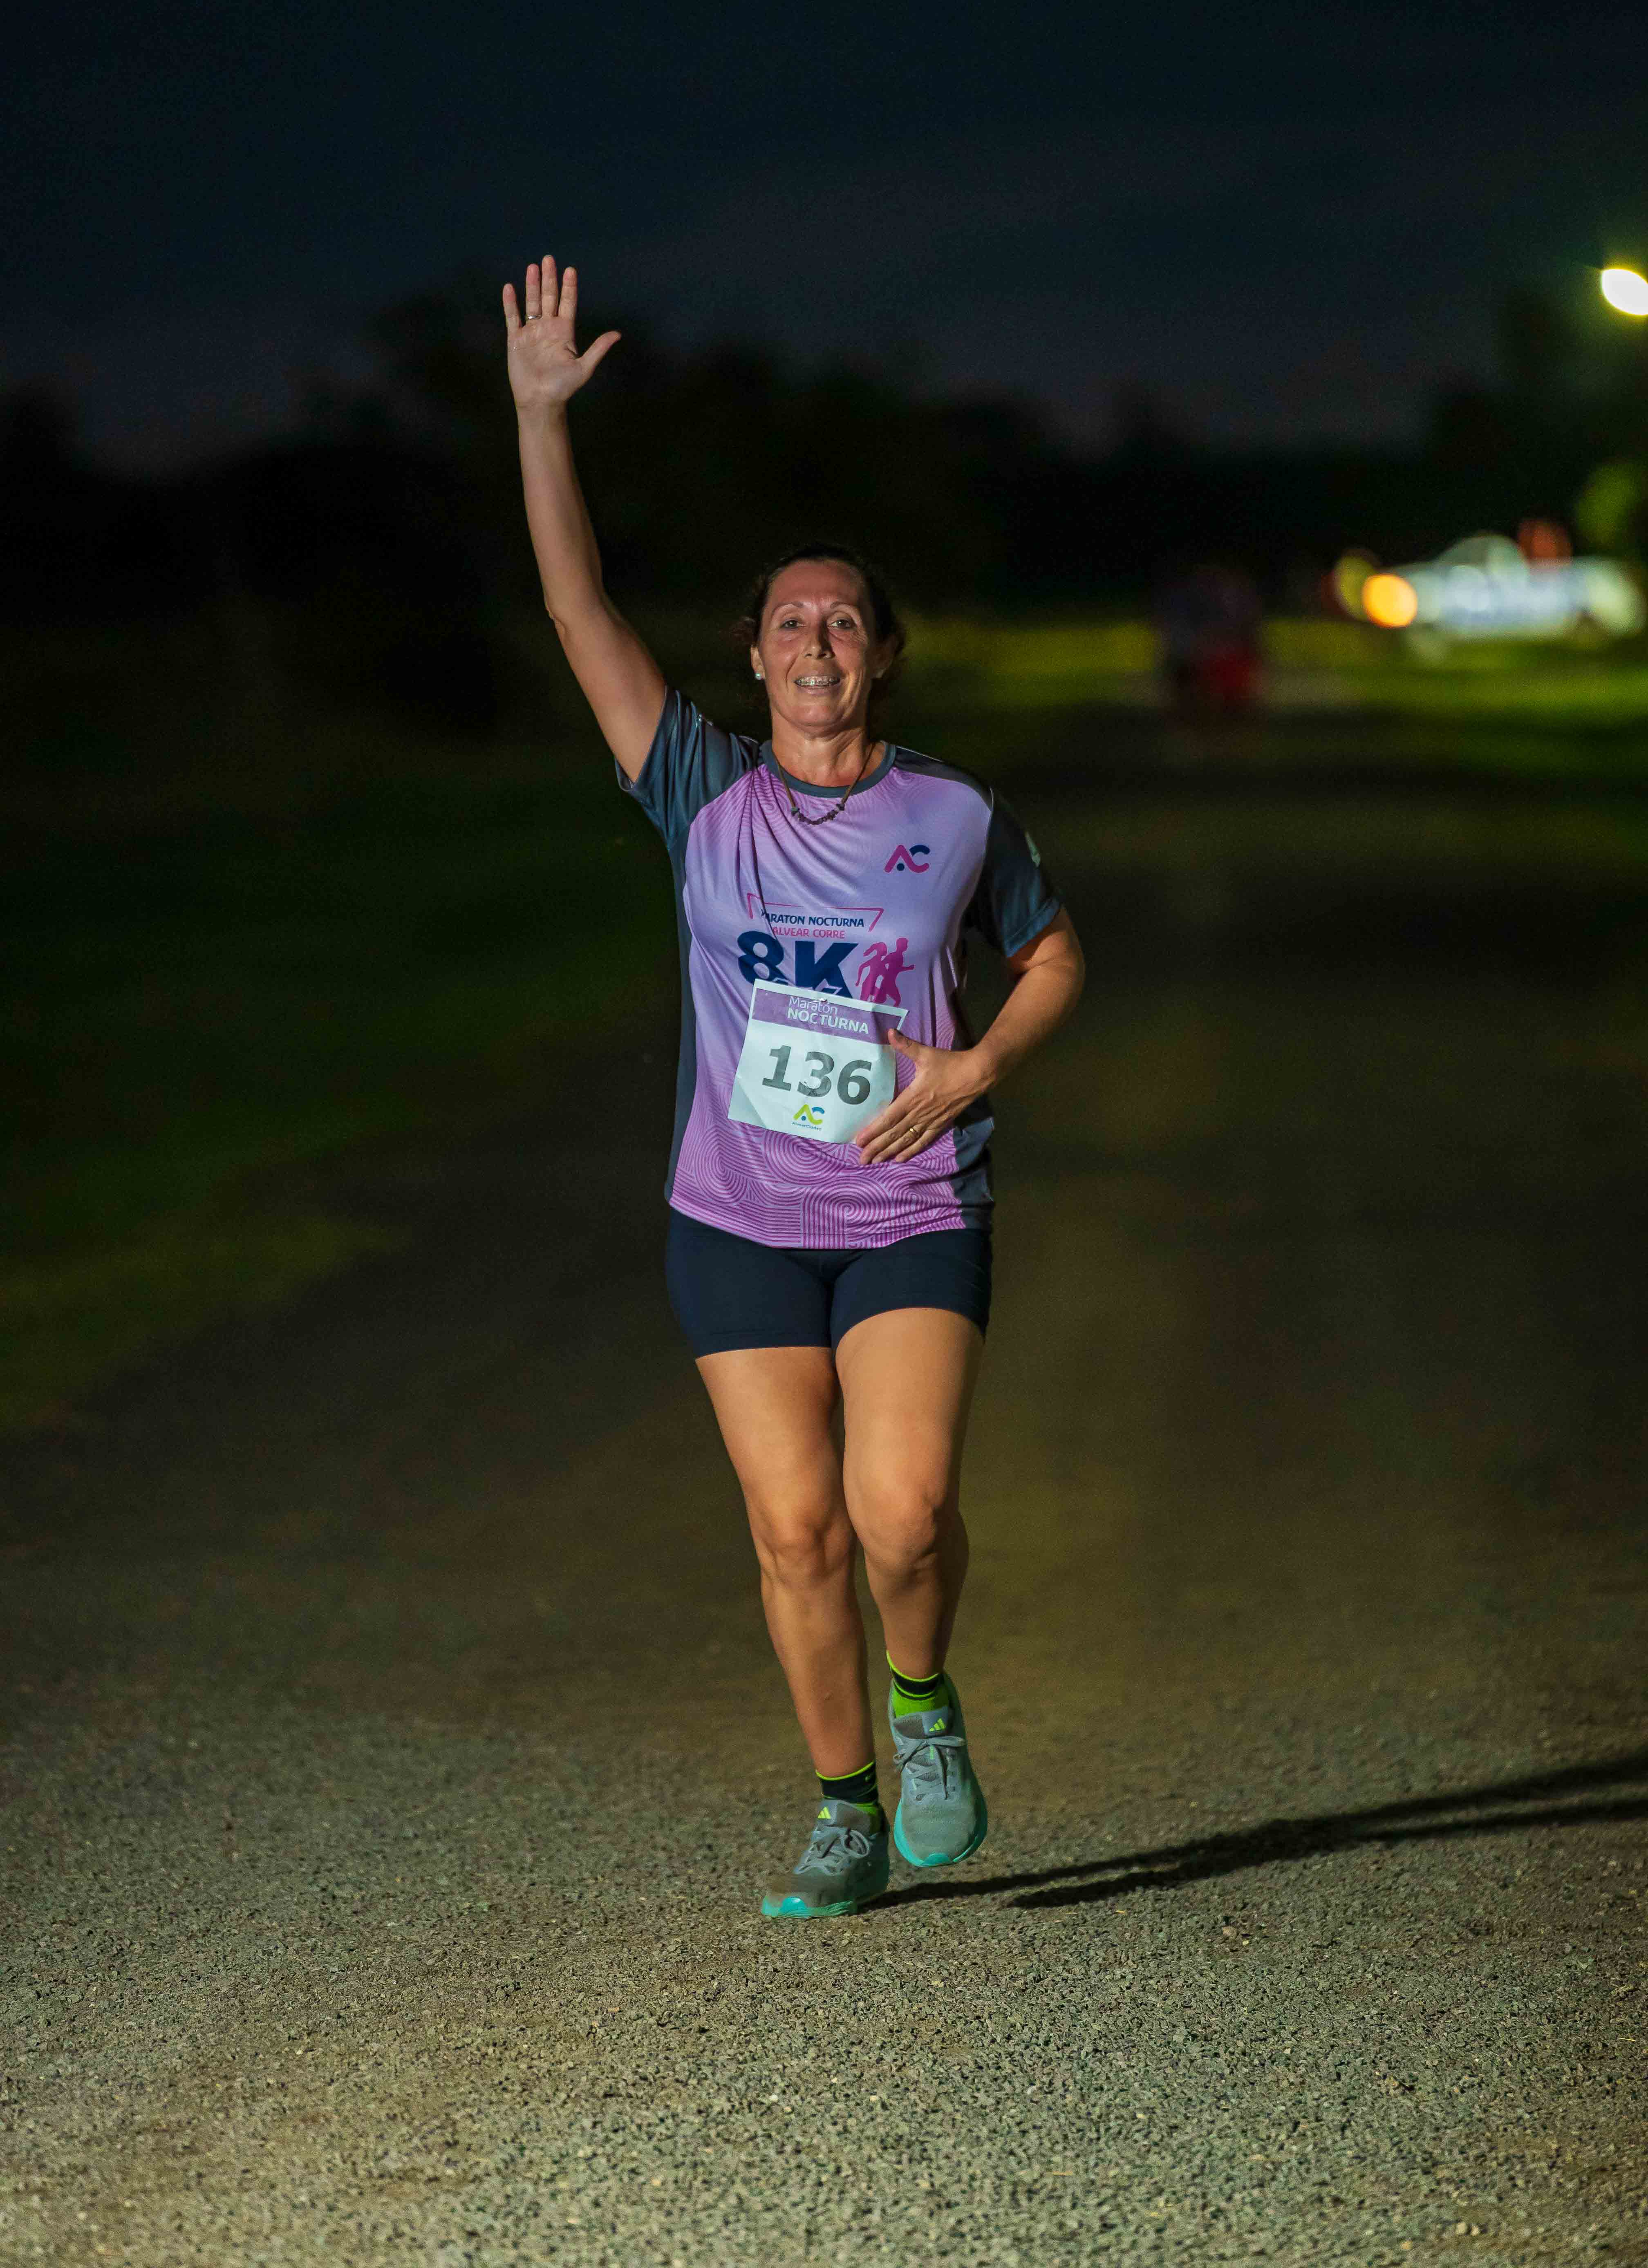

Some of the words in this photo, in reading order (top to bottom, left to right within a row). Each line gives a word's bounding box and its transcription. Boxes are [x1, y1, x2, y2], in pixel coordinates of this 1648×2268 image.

[772, 926, 809, 937] ALVEAR
[813, 929, 845, 939] CORRE
[808, 917, 864, 927] NOCTURNA
[737, 930, 859, 998] 8K
[789, 996, 837, 1015] Maratón
[787, 1007, 869, 1034] NOCTURNA
[762, 1045, 872, 1105] 136
